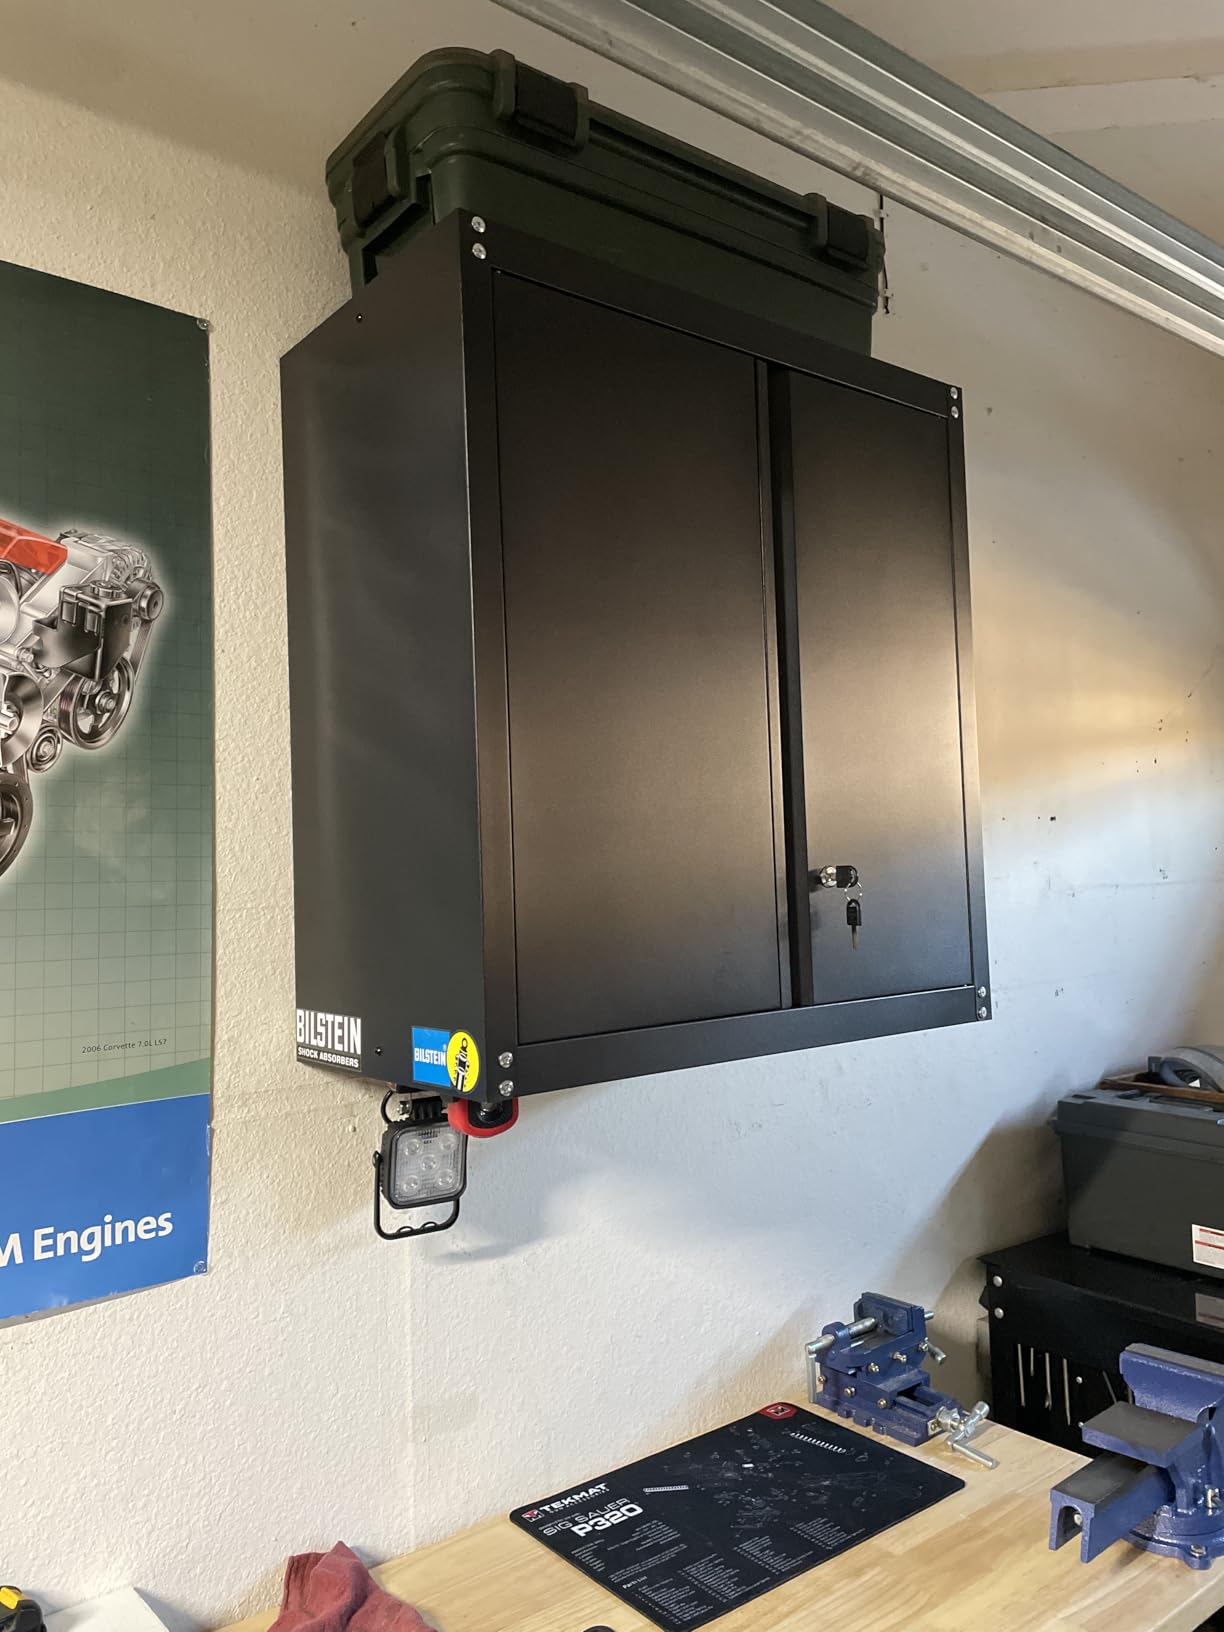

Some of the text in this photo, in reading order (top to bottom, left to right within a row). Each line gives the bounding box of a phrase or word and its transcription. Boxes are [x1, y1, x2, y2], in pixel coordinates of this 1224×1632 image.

[82, 1044, 101, 1054] 2006
[103, 1042, 135, 1051] Corvette
[154, 1038, 167, 1046] LS7
[296, 1008, 361, 1055] BILSTEIN
[298, 1046, 359, 1068] SHOCK ABSORBERS
[414, 1047, 446, 1067] BILSTEIN
[33, 1212, 174, 1263] Engines
[539, 1482, 608, 1513] TEKMAT
[543, 1521, 573, 1536] SIG
[574, 1497, 631, 1523] SAUER
[570, 1503, 644, 1537] P320
